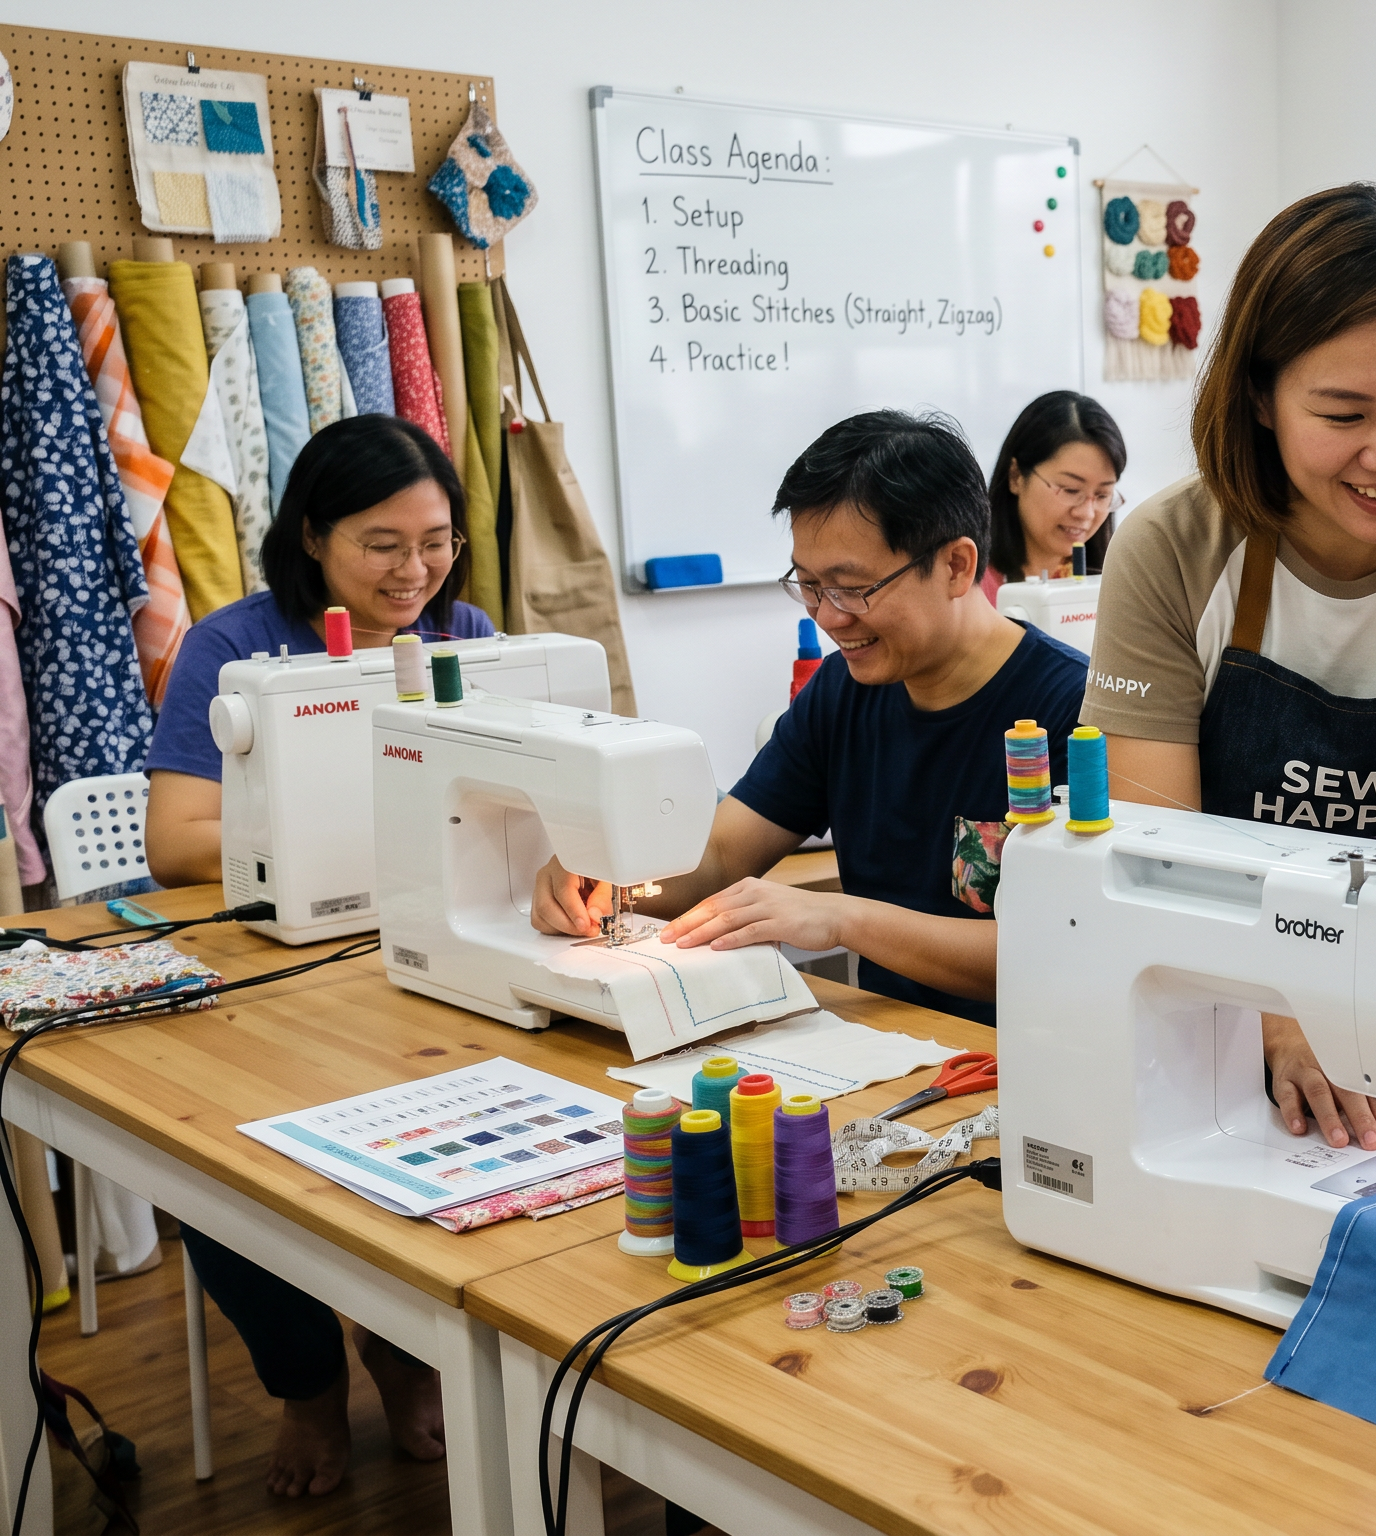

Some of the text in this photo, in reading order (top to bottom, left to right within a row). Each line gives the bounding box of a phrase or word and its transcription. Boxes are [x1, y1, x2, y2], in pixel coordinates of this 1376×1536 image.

[635, 125, 832, 184] Class Agenda:
[640, 195, 745, 239] 1. Setup
[644, 245, 790, 291] 2. Threading
[648, 291, 1003, 336] 3. Basic Stitches (Straight, Zigzag)
[649, 340, 791, 374] 4. Practice!
[1096, 672, 1152, 698] HAPPY
[293, 699, 360, 717] JANOME
[382, 744, 423, 763] JANOME
[1275, 912, 1345, 945] brother
